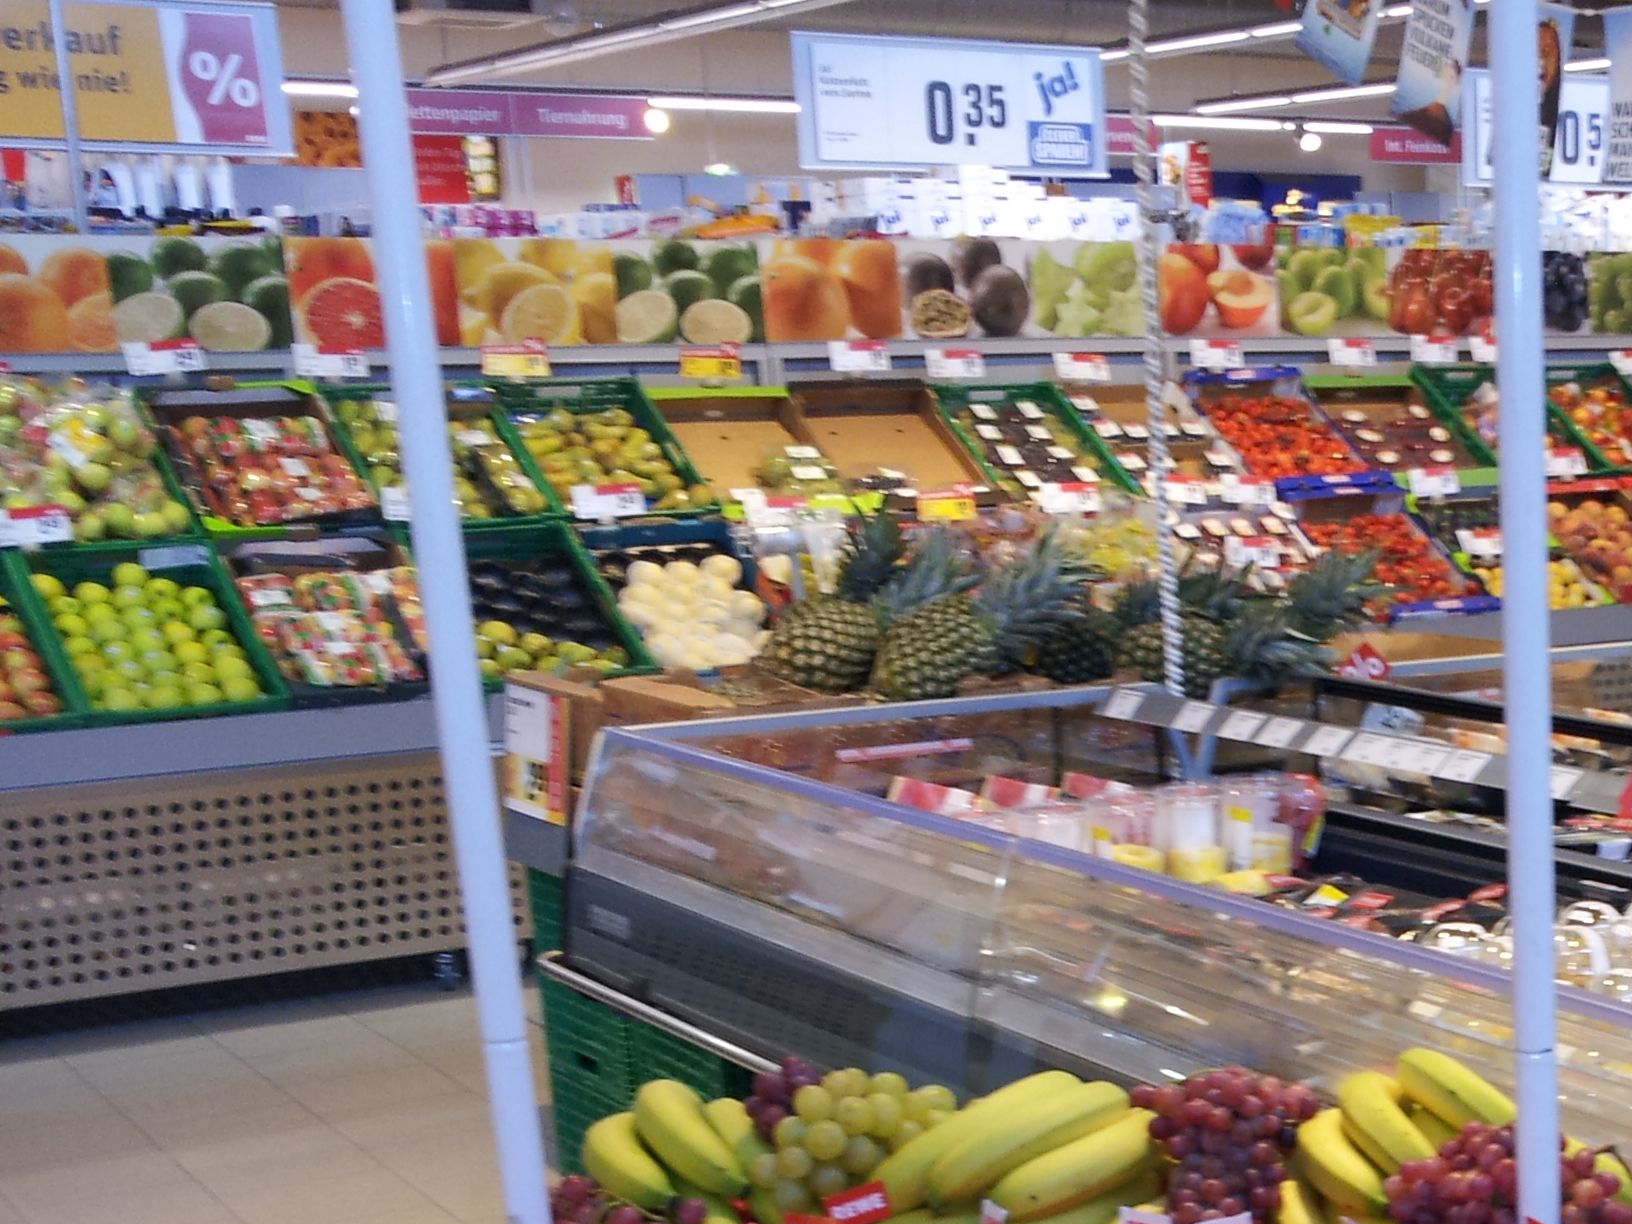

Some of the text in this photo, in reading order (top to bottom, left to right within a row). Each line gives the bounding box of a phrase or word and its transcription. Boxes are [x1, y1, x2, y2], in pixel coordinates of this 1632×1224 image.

[926, 80, 1006, 146] 0.35
[1033, 60, 1080, 116] ja!
[829, 1191, 888, 1221] REWE
